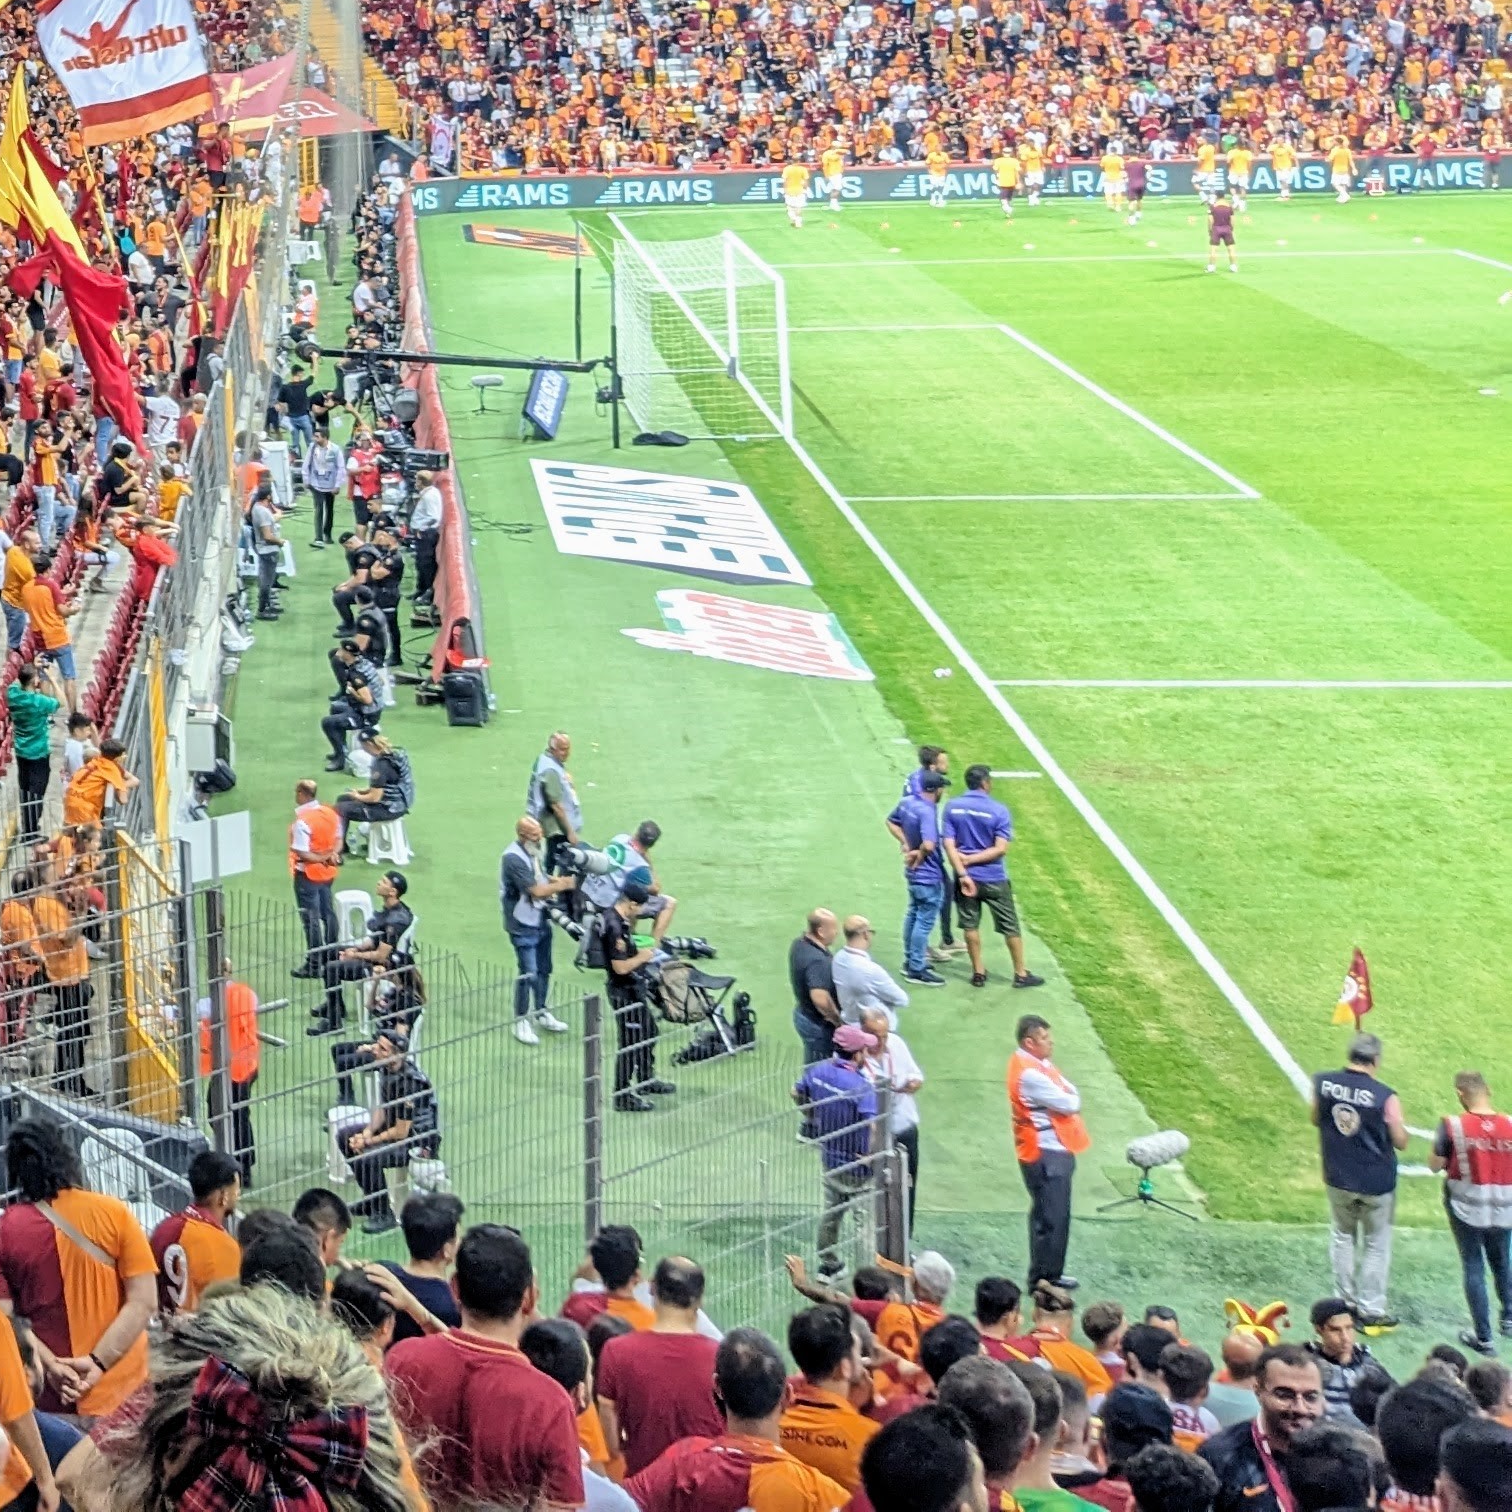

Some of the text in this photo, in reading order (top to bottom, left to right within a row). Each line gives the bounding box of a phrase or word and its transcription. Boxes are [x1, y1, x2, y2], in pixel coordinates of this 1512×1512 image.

[1390, 162, 1484, 187] RAMS
[482, 183, 569, 206] RAMS
[624, 179, 713, 204] RAMS
[164, 1243, 188, 1307] 9
